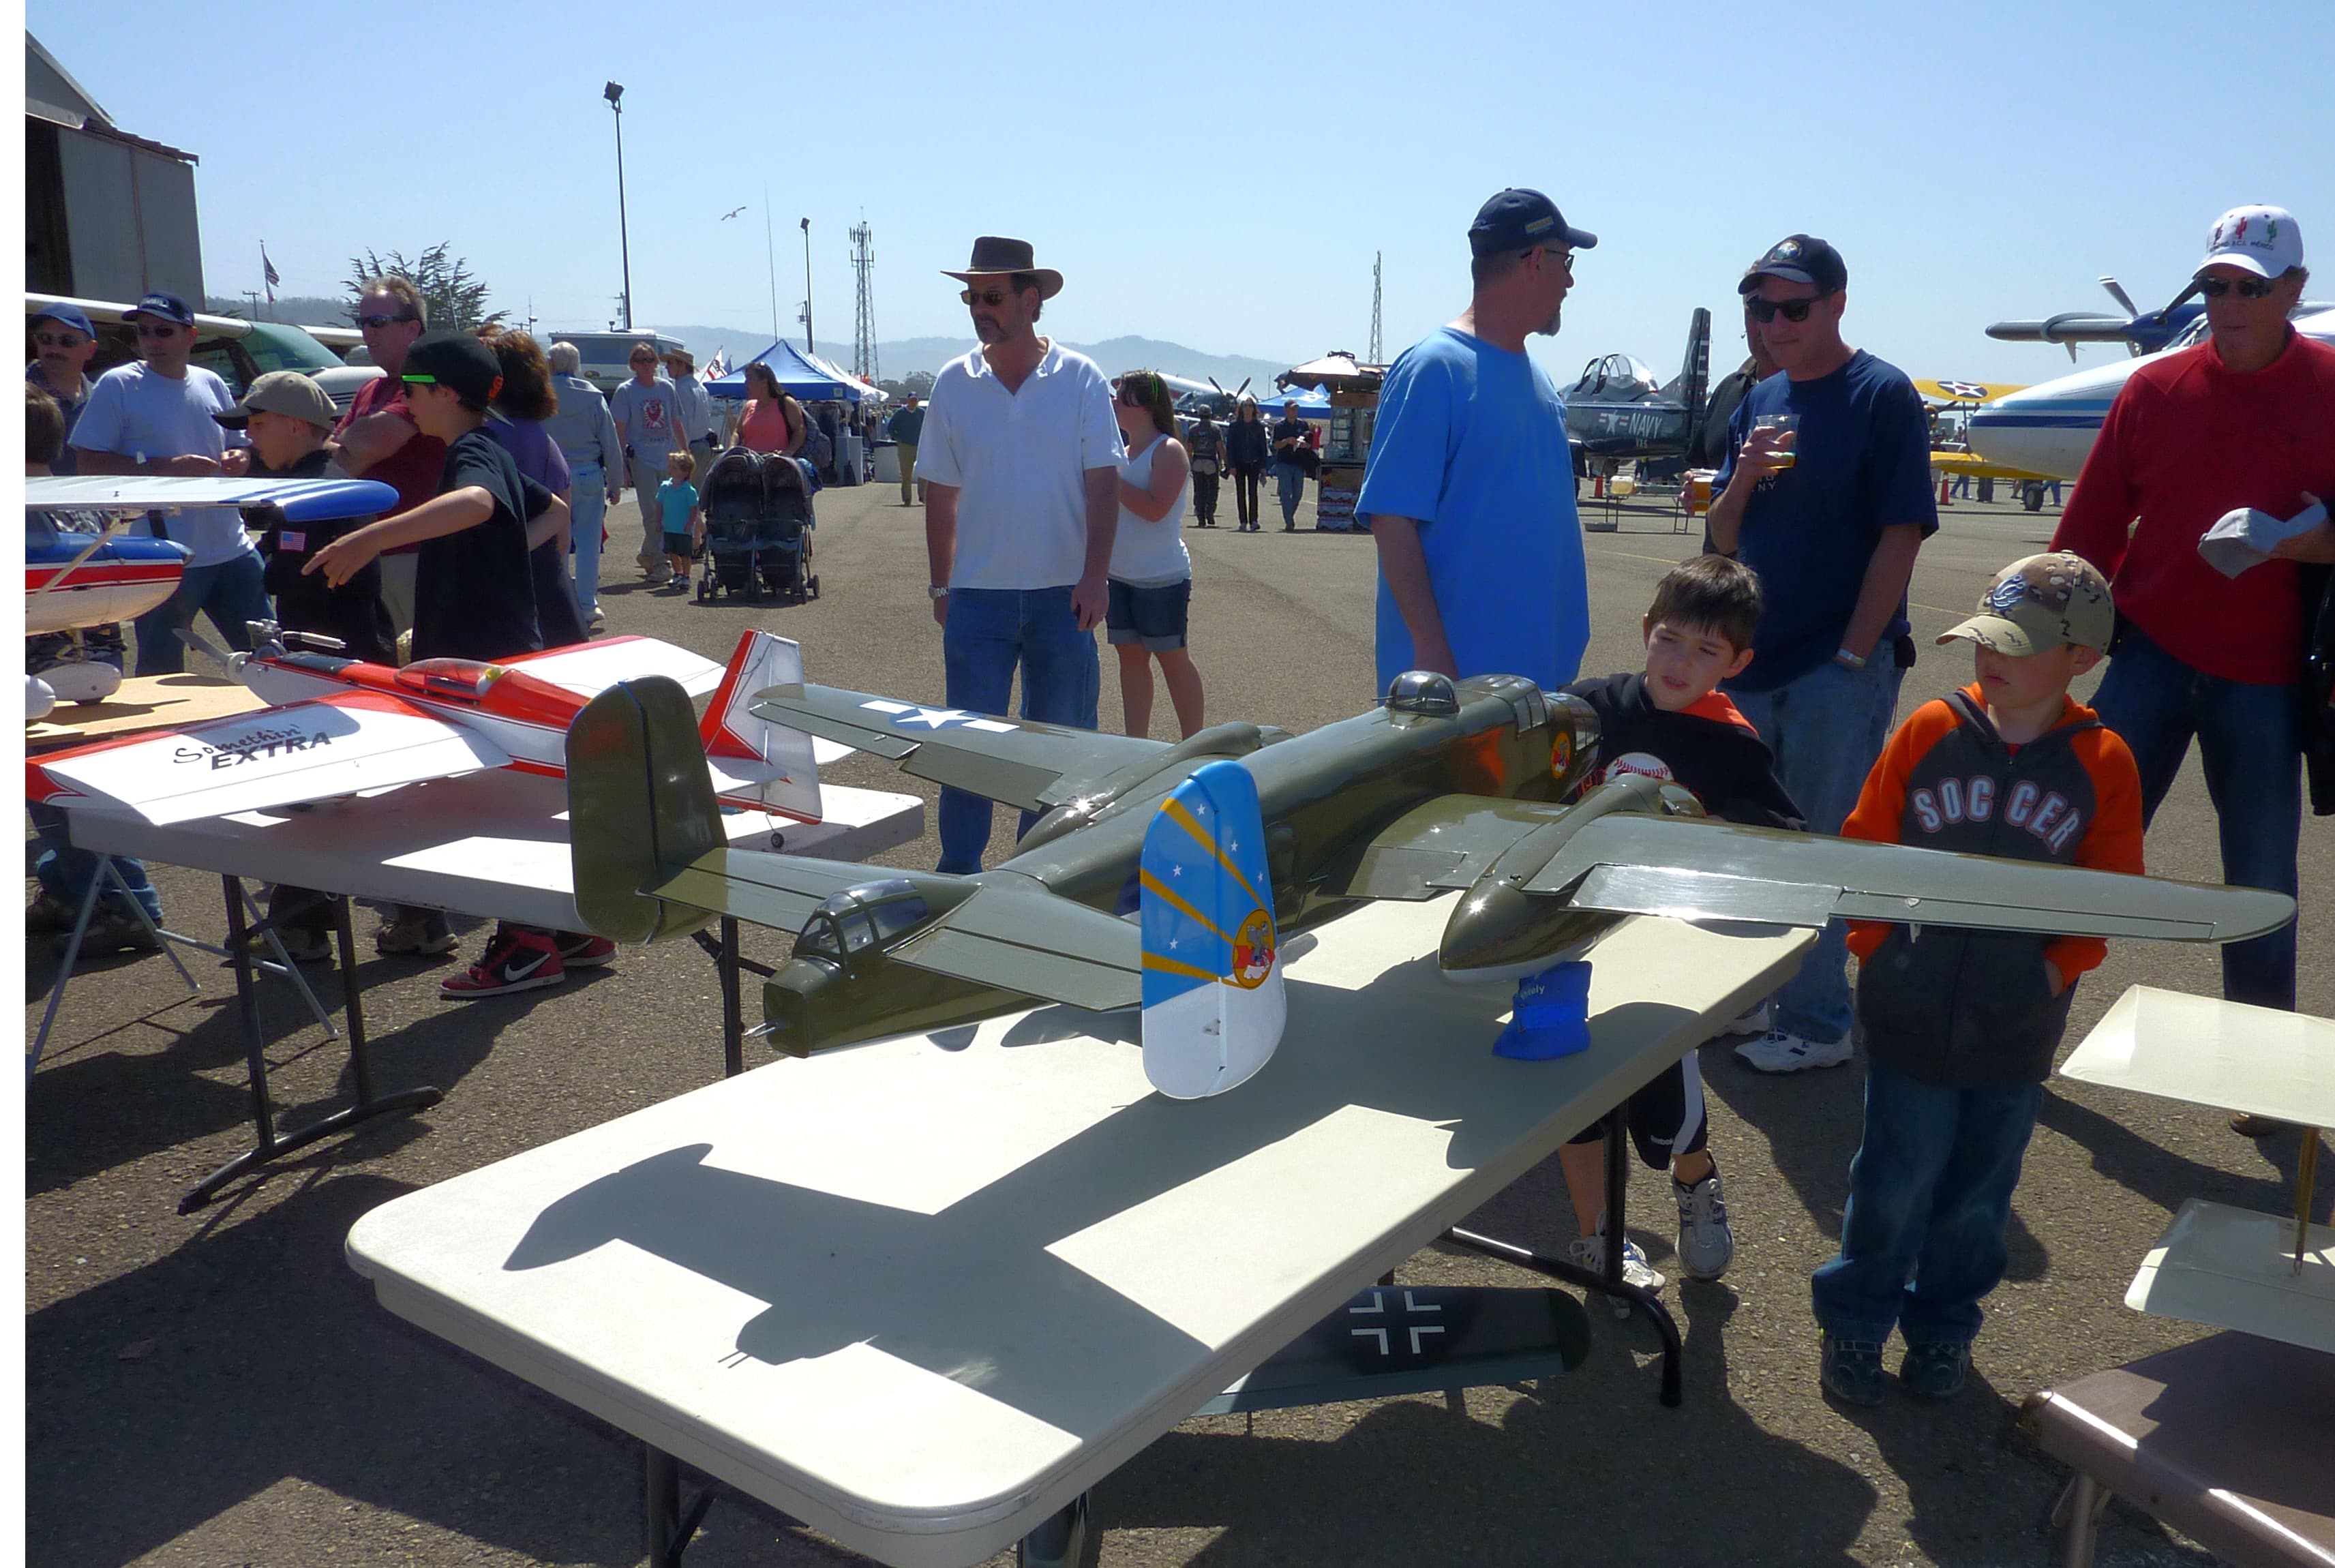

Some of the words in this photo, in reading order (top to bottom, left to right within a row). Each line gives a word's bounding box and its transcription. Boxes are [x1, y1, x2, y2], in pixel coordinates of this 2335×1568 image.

[1629, 412, 1662, 439] NAVY
[211, 732, 332, 770] EXTRA
[1911, 774, 2080, 855] SOCCER
